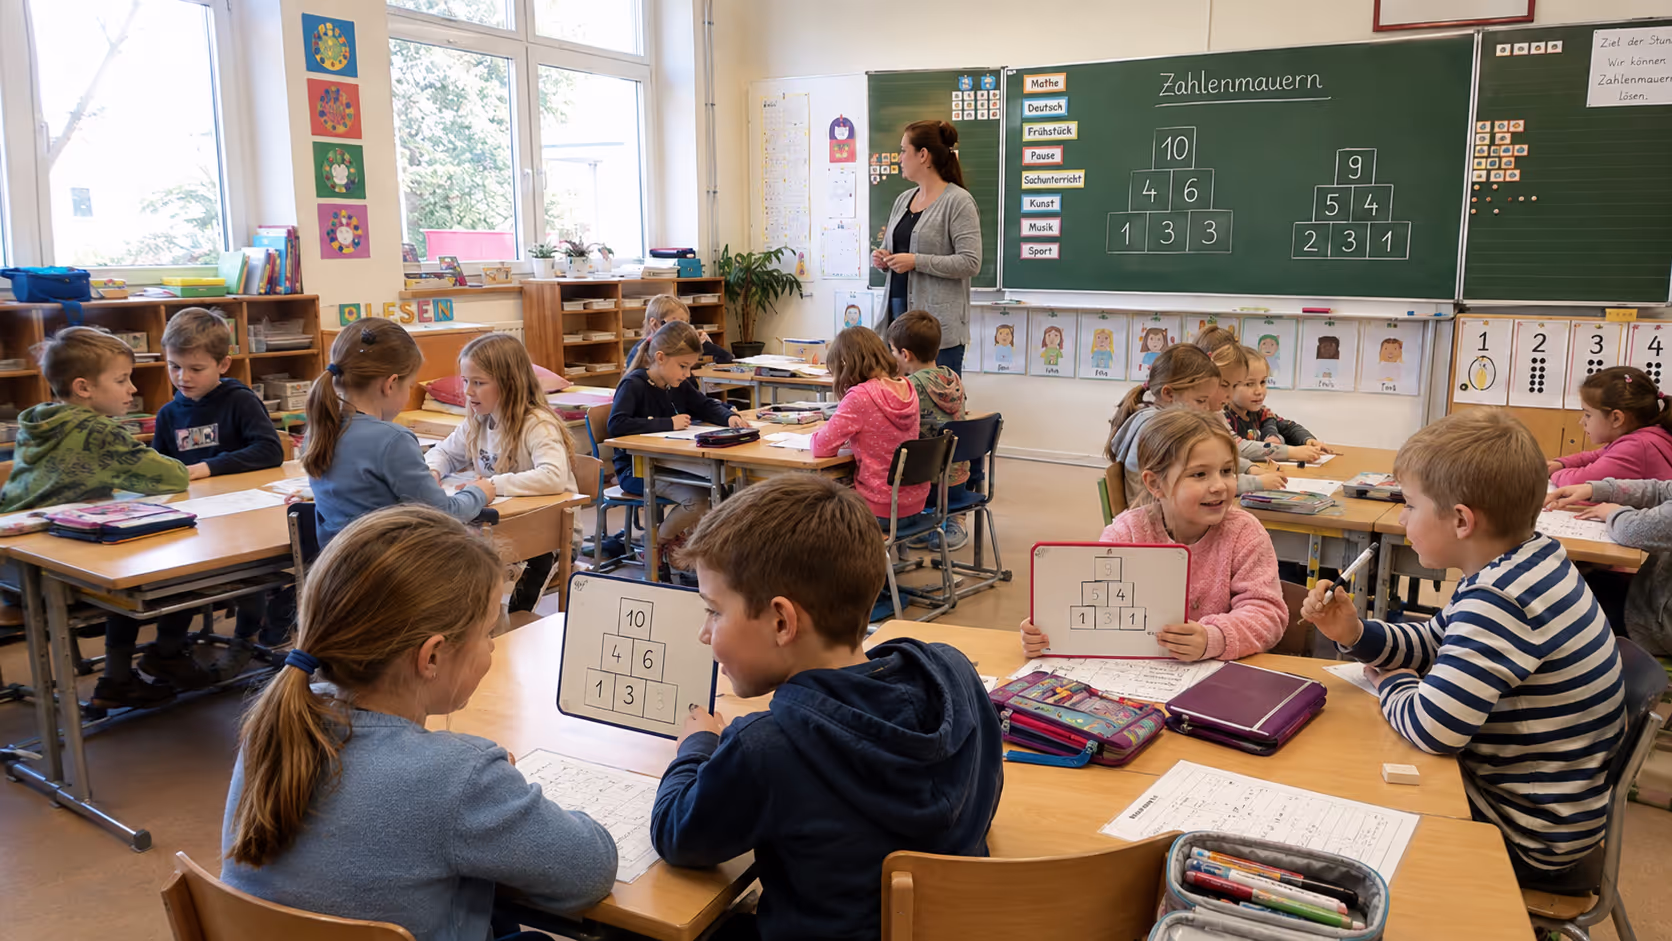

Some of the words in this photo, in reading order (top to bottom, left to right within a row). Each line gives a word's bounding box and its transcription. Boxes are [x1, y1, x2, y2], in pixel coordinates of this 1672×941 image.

[1600, 37, 1621, 48] Ziel
[1627, 36, 1644, 46] der
[1608, 57, 1625, 67] Wir
[1031, 78, 1059, 89] Mathe
[1159, 69, 1323, 97] Zahlenmauern
[1618, 90, 1648, 101] lösen.
[1027, 102, 1063, 113] Deutsch
[1027, 125, 1073, 137] Frühstück
[1030, 150, 1056, 161] Pause
[1161, 135, 1189, 161] 10
[1348, 155, 1362, 180] 9
[1023, 174, 1082, 185] Sachunterricht
[1142, 179, 1158, 203] 4
[1183, 177, 1198, 203] 6
[1029, 199, 1056, 208] Kunst
[1324, 193, 1339, 216] 5
[1363, 193, 1379, 216] 4
[1028, 222, 1054, 233] Musik
[1120, 221, 1131, 245] 1
[1159, 220, 1175, 245] 3
[1201, 220, 1217, 245] 3
[1303, 230, 1318, 252] 2
[1341, 229, 1357, 253] 3
[1381, 230, 1392, 252] 1
[1028, 246, 1052, 258] Sport
[1477, 331, 1490, 352] 1
[1531, 332, 1547, 353] 2
[1589, 334, 1604, 355] 3
[1647, 335, 1664, 357] 4
[1091, 587, 1100, 601] 5
[1116, 588, 1126, 602] 4
[625, 609, 646, 629] 10
[1078, 612, 1086, 625] 1
[1103, 611, 1113, 625] 3
[1128, 612, 1136, 626] 1
[611, 643, 622, 664] 4
[642, 649, 654, 670] 6
[595, 679, 604, 699] 1
[623, 684, 635, 705] 3
